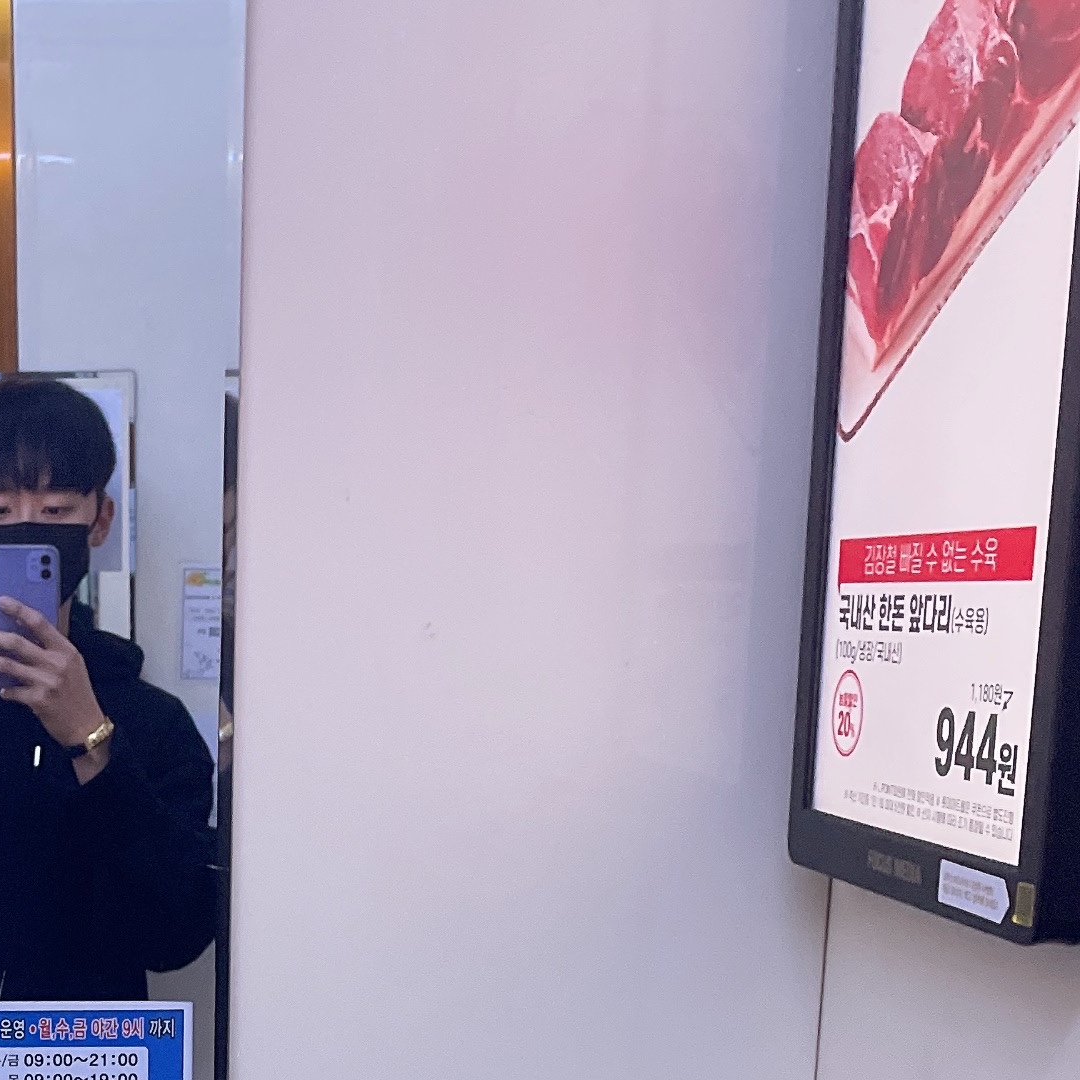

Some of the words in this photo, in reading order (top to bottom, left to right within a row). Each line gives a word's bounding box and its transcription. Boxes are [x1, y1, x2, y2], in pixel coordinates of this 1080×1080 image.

[865, 545, 896, 575] 김장철
[925, 543, 938, 573] 수
[941, 540, 967, 573] 없는
[971, 537, 999, 572] 수육
[840, 594, 876, 630] 국내산
[879, 594, 905, 632] 한돈
[935, 707, 1018, 796] 944원
[0, 1019, 25, 1039] 운영
[91, 1017, 119, 1039] 야간
[122, 1016, 145, 1039] 9시
[149, 1017, 176, 1039] 까지
